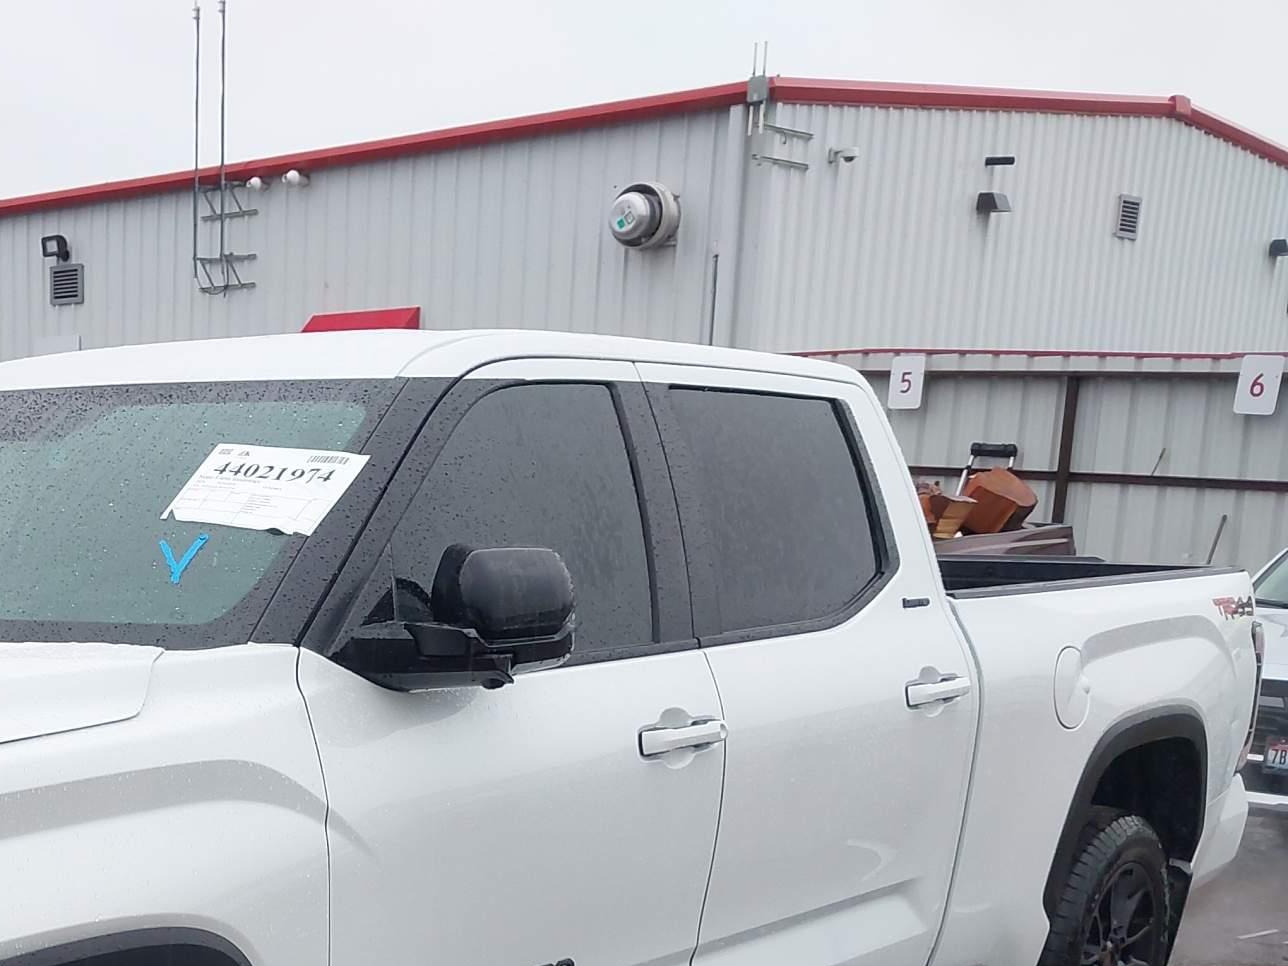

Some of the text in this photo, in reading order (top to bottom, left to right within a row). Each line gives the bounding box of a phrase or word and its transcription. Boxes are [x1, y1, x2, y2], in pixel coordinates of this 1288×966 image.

[898, 371, 913, 394] 5
[1248, 373, 1265, 398] 6
[213, 461, 336, 485] 44021974
